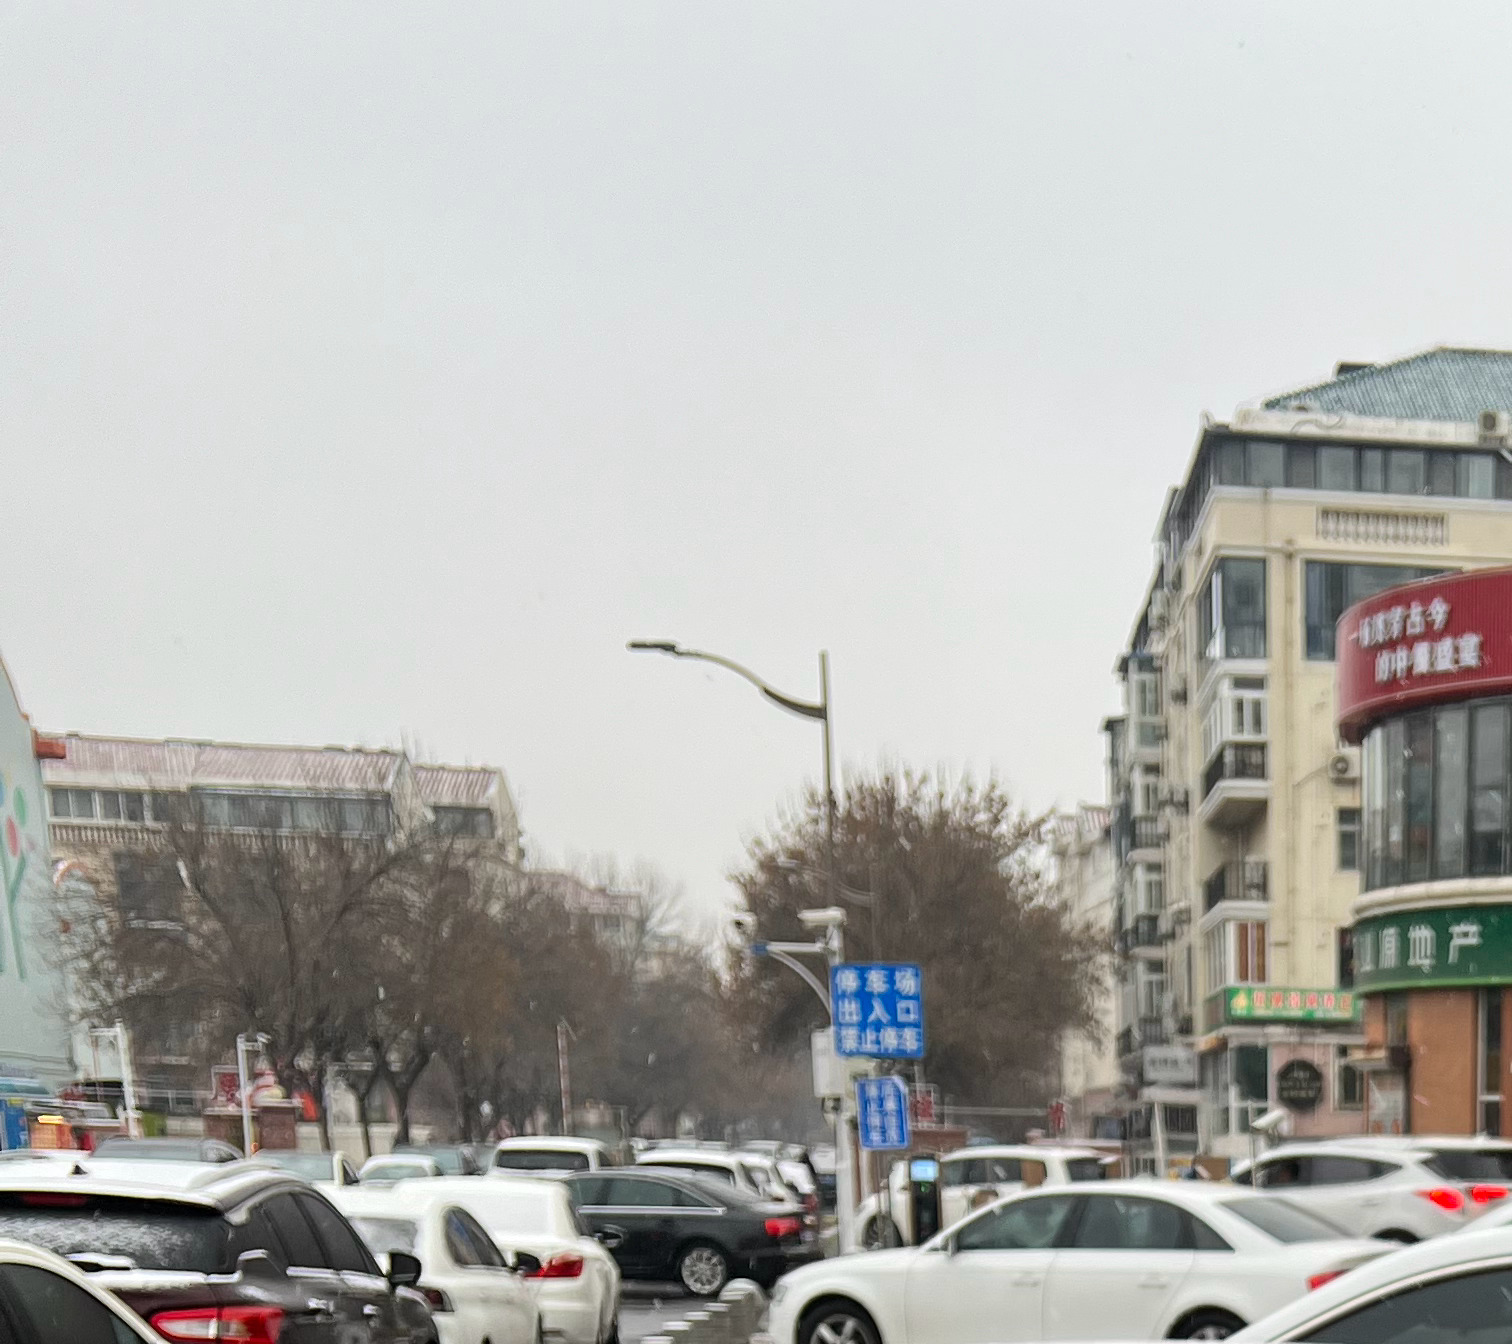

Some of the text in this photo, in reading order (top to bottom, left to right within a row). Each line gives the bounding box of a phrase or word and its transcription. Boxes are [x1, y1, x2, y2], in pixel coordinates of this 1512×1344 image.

[836, 967, 921, 997] 停车场
[838, 997, 920, 1026] 出入口
[840, 1025, 924, 1055] 禁止停车
